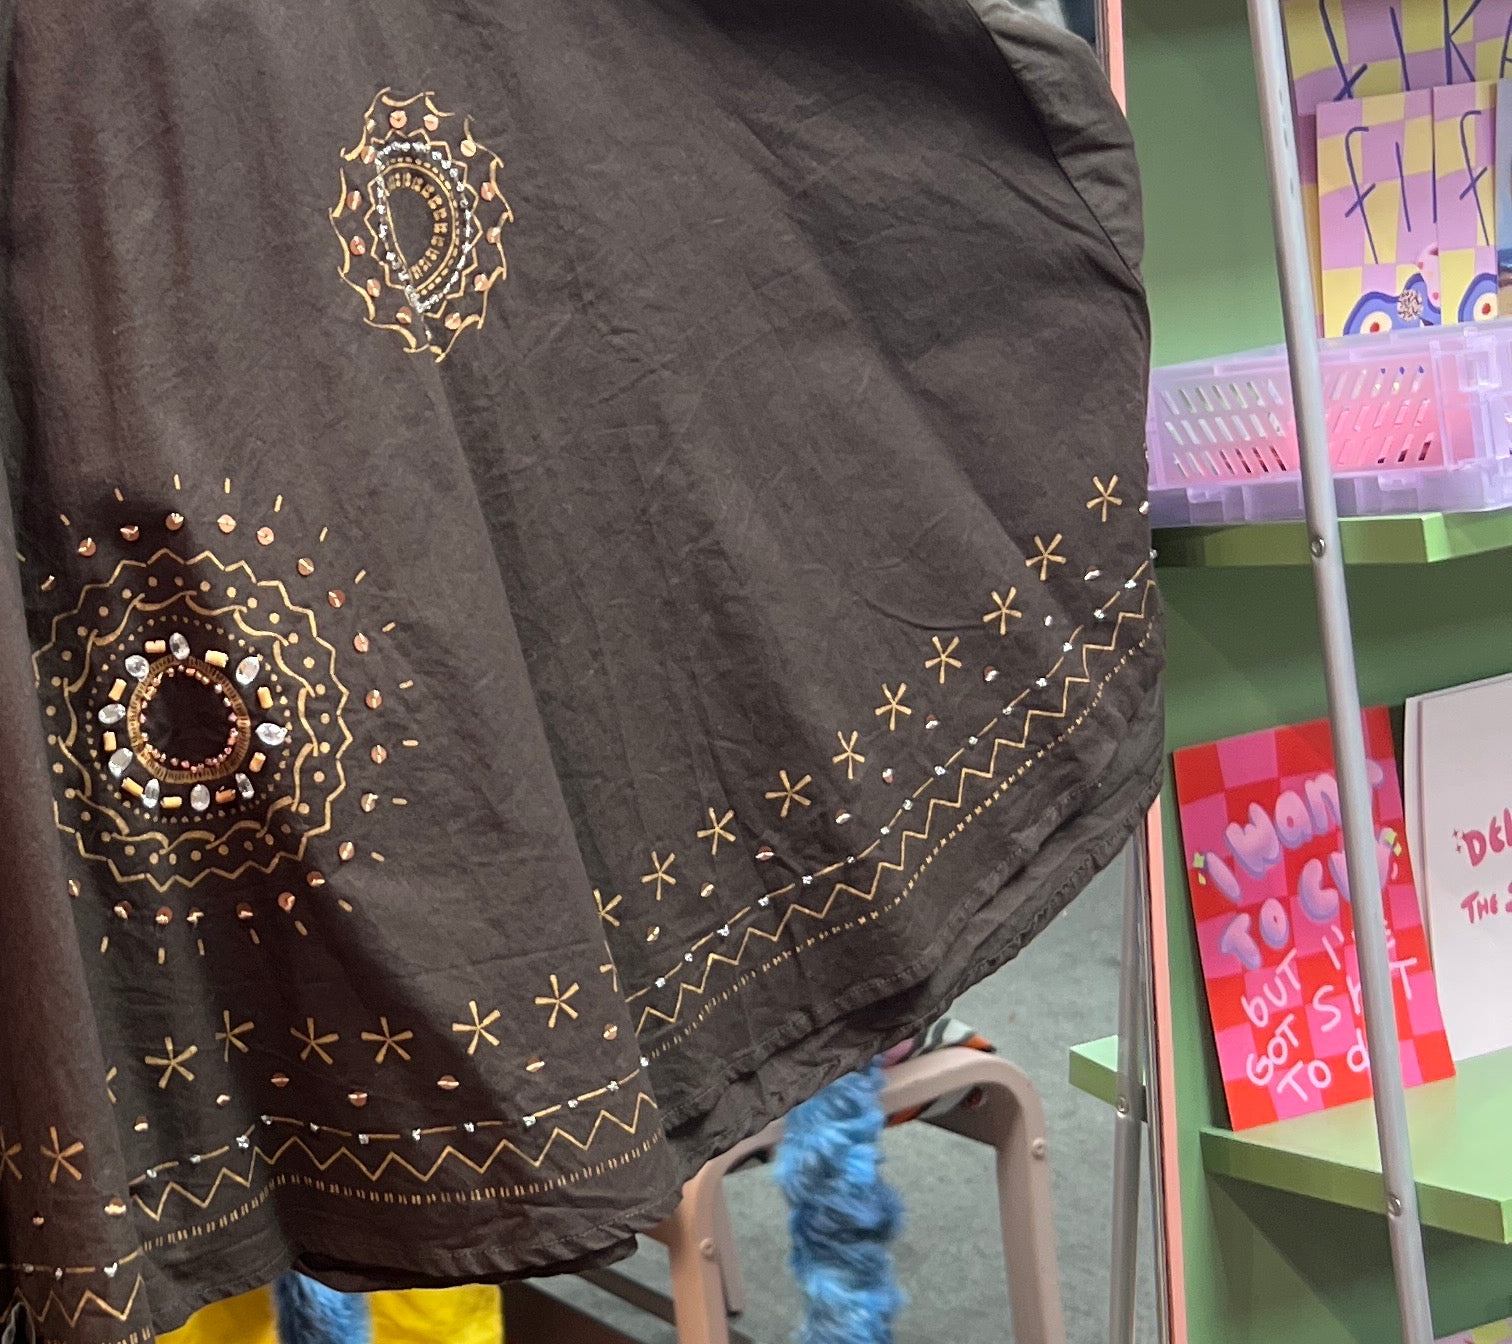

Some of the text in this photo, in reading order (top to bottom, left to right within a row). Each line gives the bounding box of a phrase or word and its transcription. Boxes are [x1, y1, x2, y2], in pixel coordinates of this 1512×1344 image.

[1219, 898, 1290, 972] TO
[1245, 1013, 1300, 1087] GOT
[1276, 1059, 1333, 1102] TO
